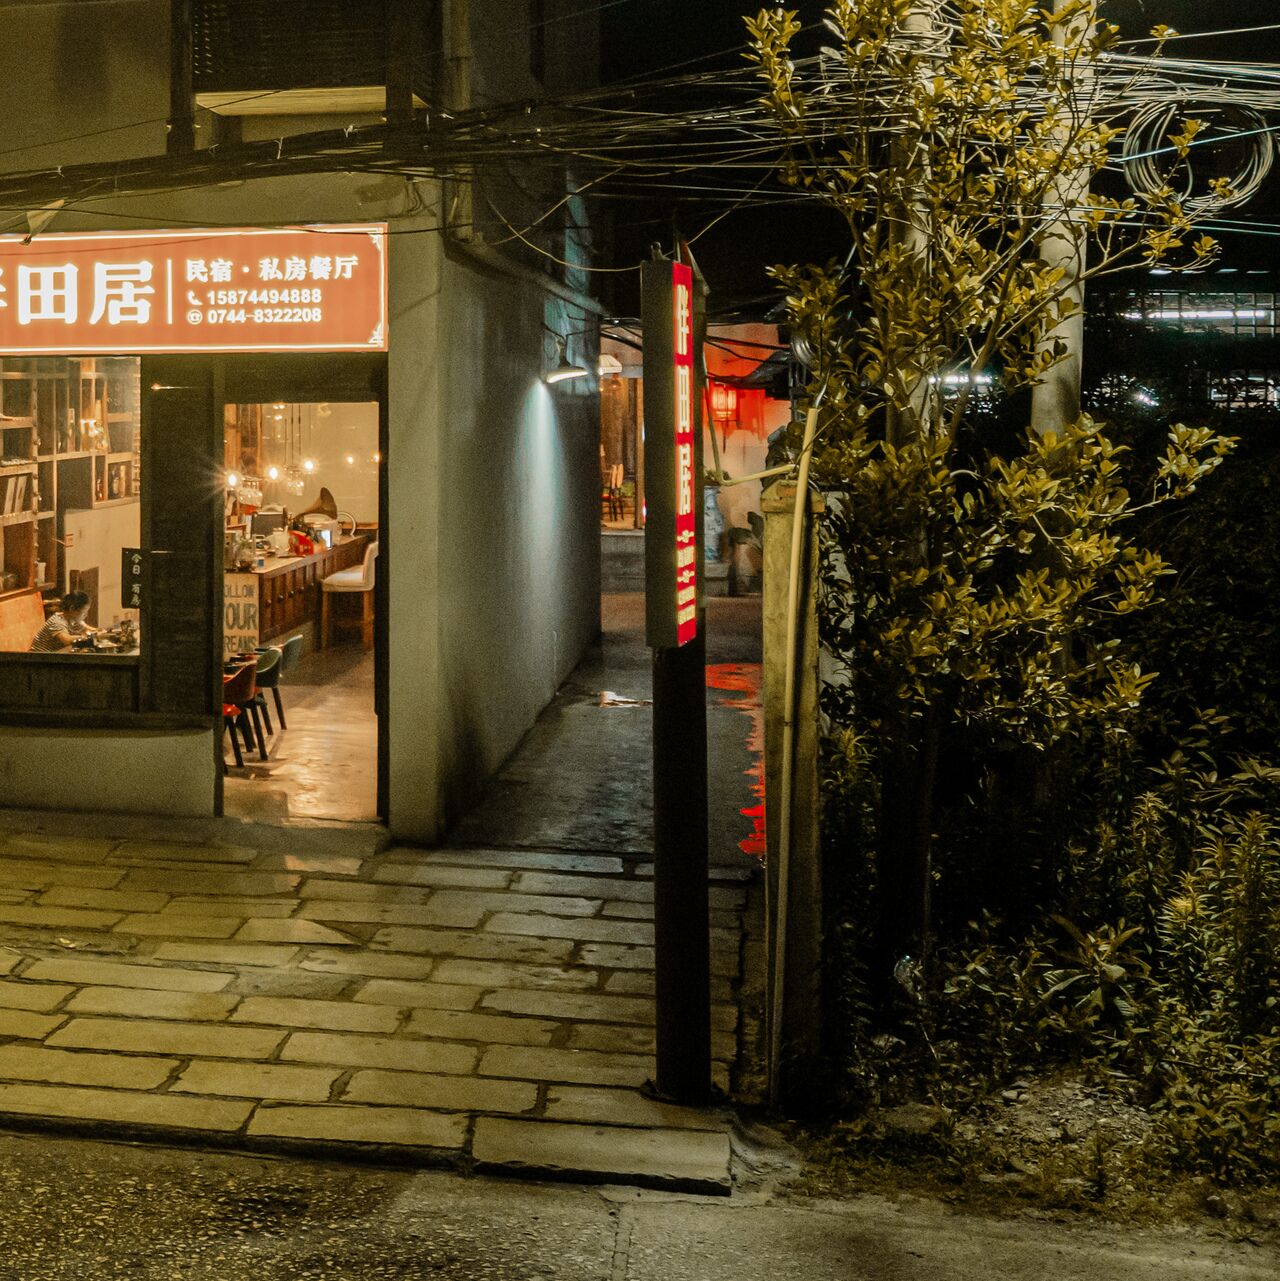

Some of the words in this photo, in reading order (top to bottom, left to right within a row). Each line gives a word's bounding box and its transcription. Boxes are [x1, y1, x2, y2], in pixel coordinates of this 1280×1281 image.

[207, 289, 322, 305] 15874494888
[207, 308, 322, 324] 0744-8322208
[224, 584, 255, 598] OLLOW
[224, 602, 258, 630] OUR
[224, 635, 257, 653] REAMS
